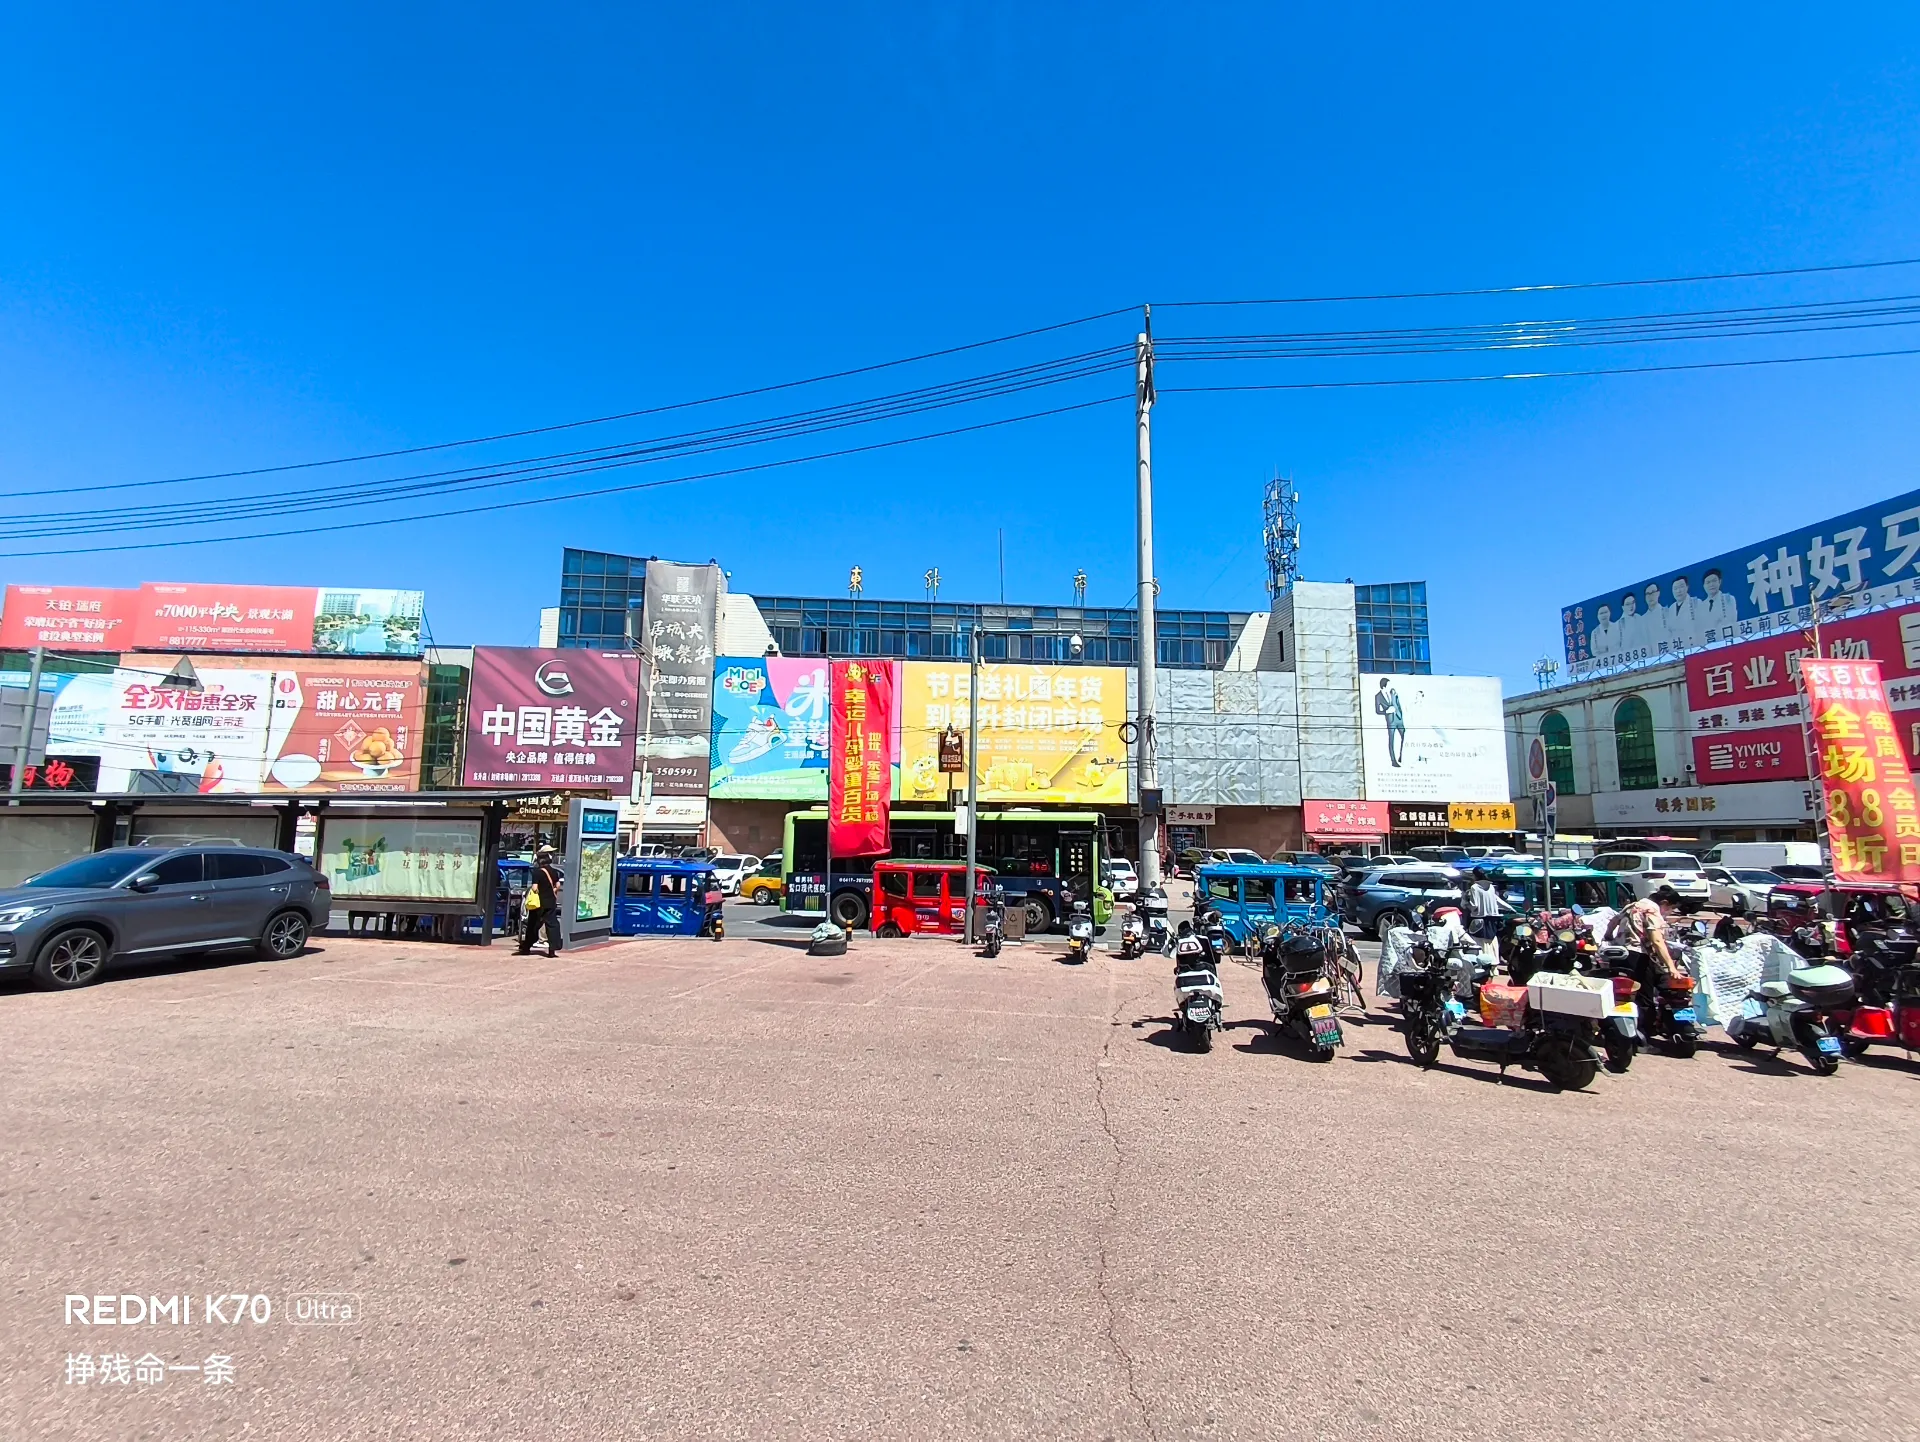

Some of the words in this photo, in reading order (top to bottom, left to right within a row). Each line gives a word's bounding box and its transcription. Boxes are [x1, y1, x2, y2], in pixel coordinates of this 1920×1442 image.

[1747, 505, 1920, 613] 种好牙
[169, 637, 207, 646] 8817777
[730, 668, 760, 681] MIQI
[725, 678, 764, 692] SHOES
[121, 684, 258, 711] 全家福惠全家
[316, 691, 405, 712] 甜心元宵
[1738, 708, 1765, 723] 男装
[481, 704, 624, 747] 中国黄金
[1735, 741, 1781, 757] YIYIKU
[505, 751, 548, 764] 央企品牌
[553, 752, 596, 765] 值得信赖
[655, 767, 698, 777] 3505991
[1817, 702, 1888, 873] 全场8.8折
[1866, 711, 1920, 866] 每周三会员日
[519, 807, 540, 815] China
[1452, 808, 1512, 821] 外贸牛仔裤
